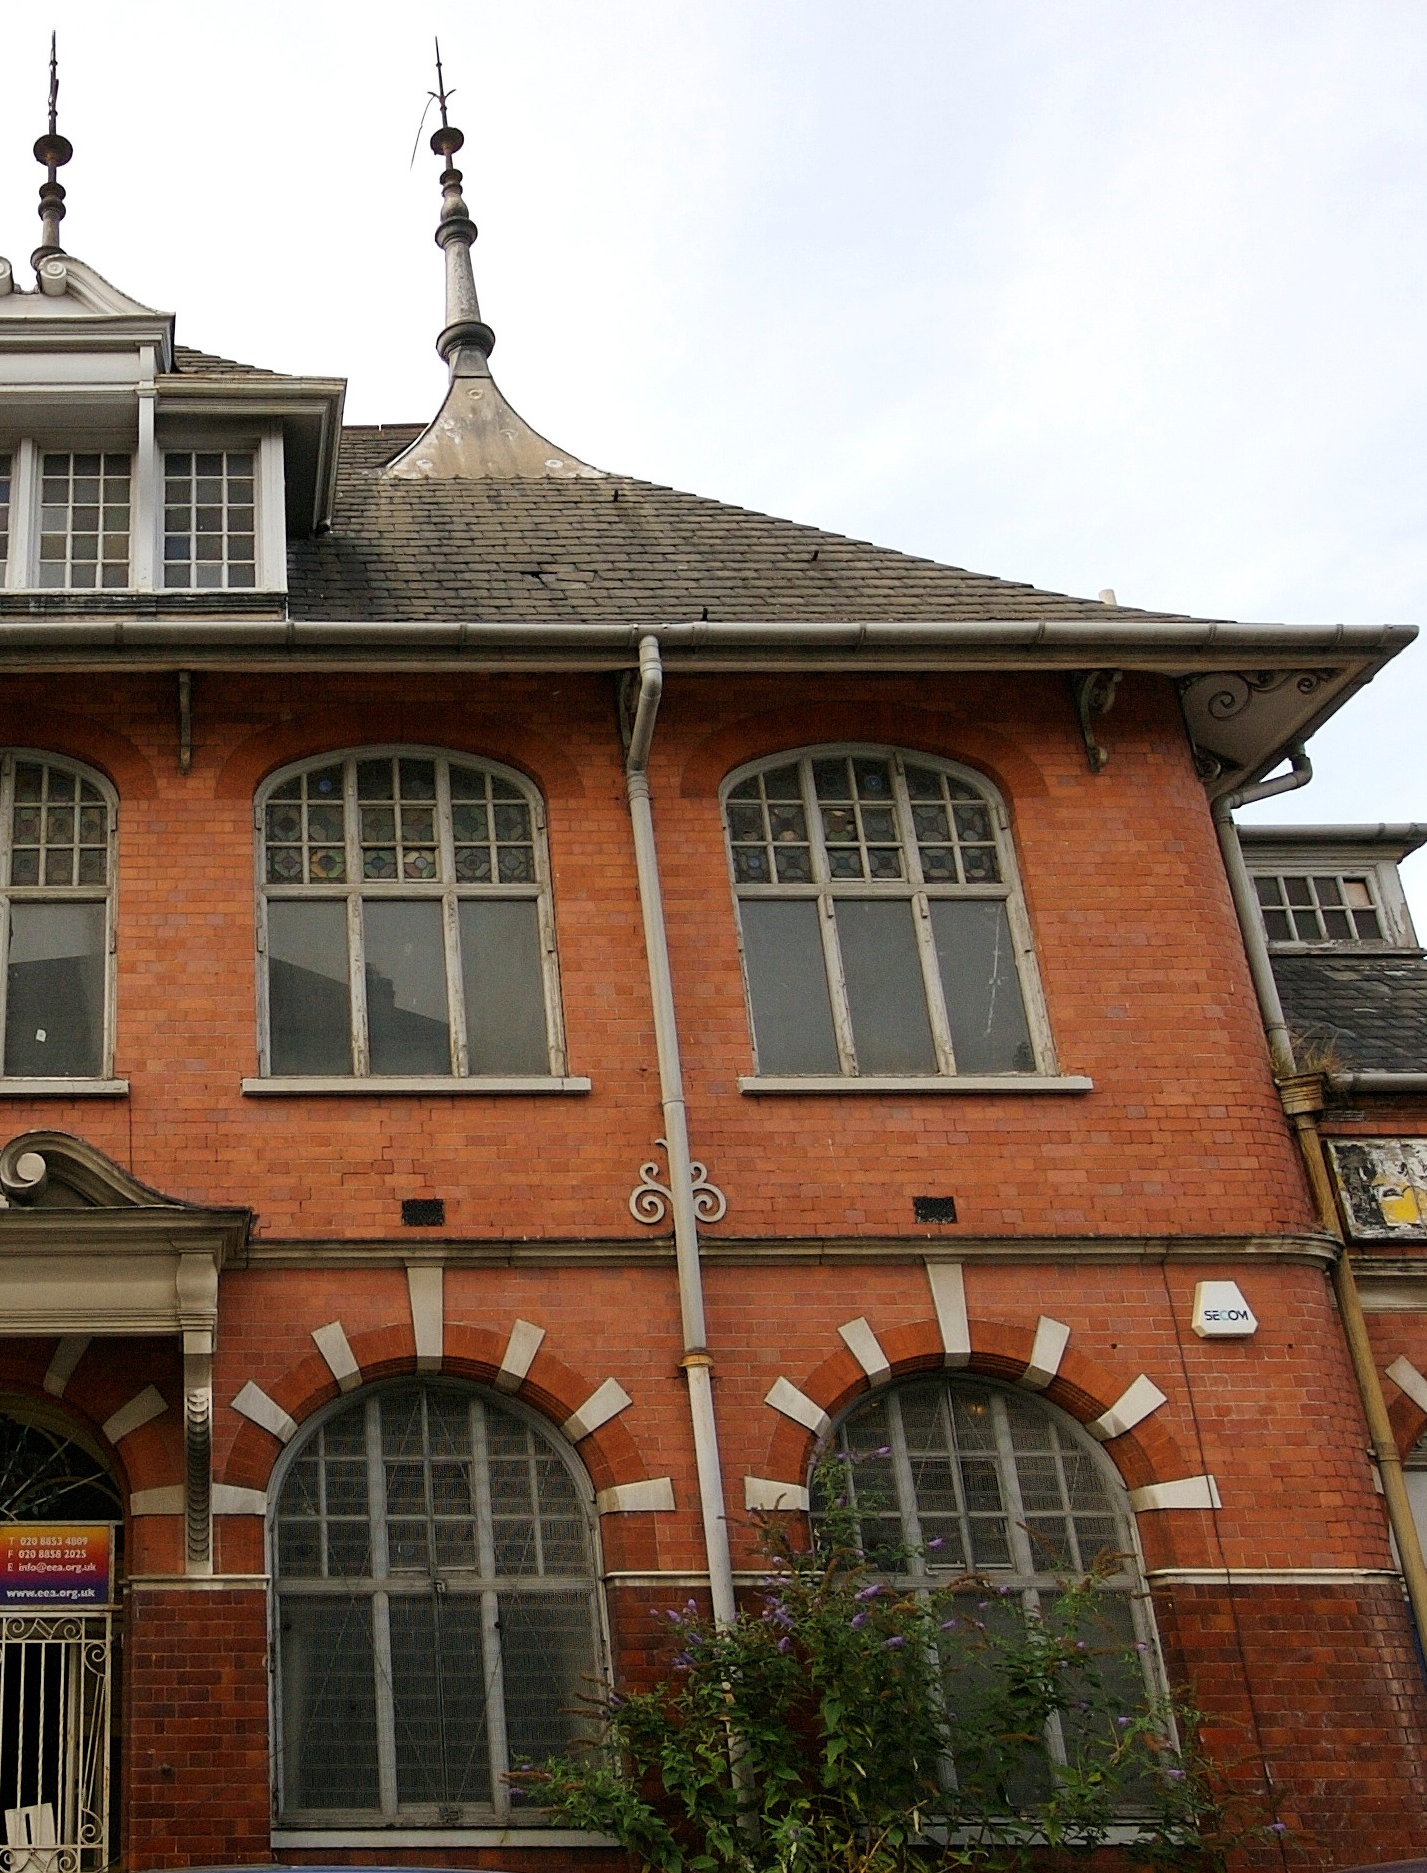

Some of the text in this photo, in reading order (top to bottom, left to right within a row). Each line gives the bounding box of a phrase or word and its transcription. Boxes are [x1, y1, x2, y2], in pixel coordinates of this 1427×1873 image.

[1204, 1309, 1249, 1321] SECOM
[8, 1537, 15, 1545] T
[20, 1537, 37, 1546] 020
[40, 1537, 62, 1546] 8853
[8, 1550, 87, 1558] F 020 8858 2025
[7, 1562, 96, 1573] E info@eea.org.uk
[6, 1588, 95, 1599] www.eea.org.uk
